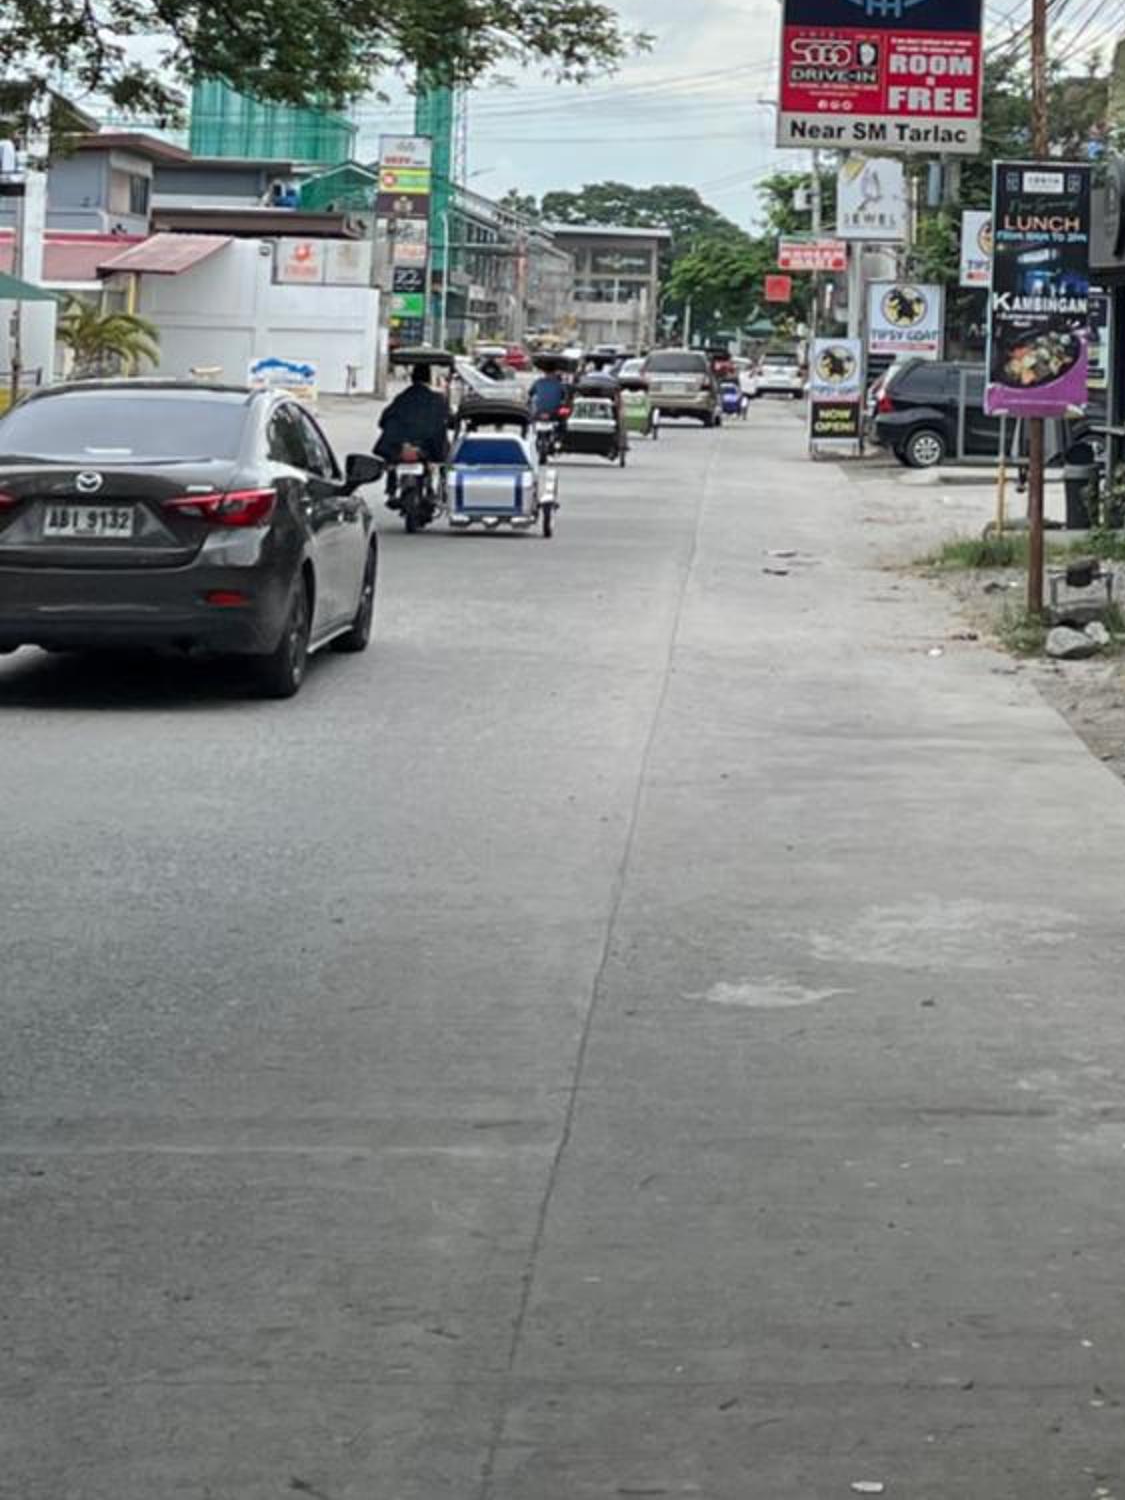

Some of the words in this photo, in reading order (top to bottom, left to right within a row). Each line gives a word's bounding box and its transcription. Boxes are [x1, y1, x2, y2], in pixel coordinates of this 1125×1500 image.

[790, 68, 877, 84] DRIVE-IN
[889, 53, 973, 76] ROOM
[888, 85, 973, 112] FREE
[790, 119, 846, 140] Near
[853, 121, 887, 141] SM
[895, 124, 968, 144] Tarlac
[1004, 214, 1080, 231] LUNCH
